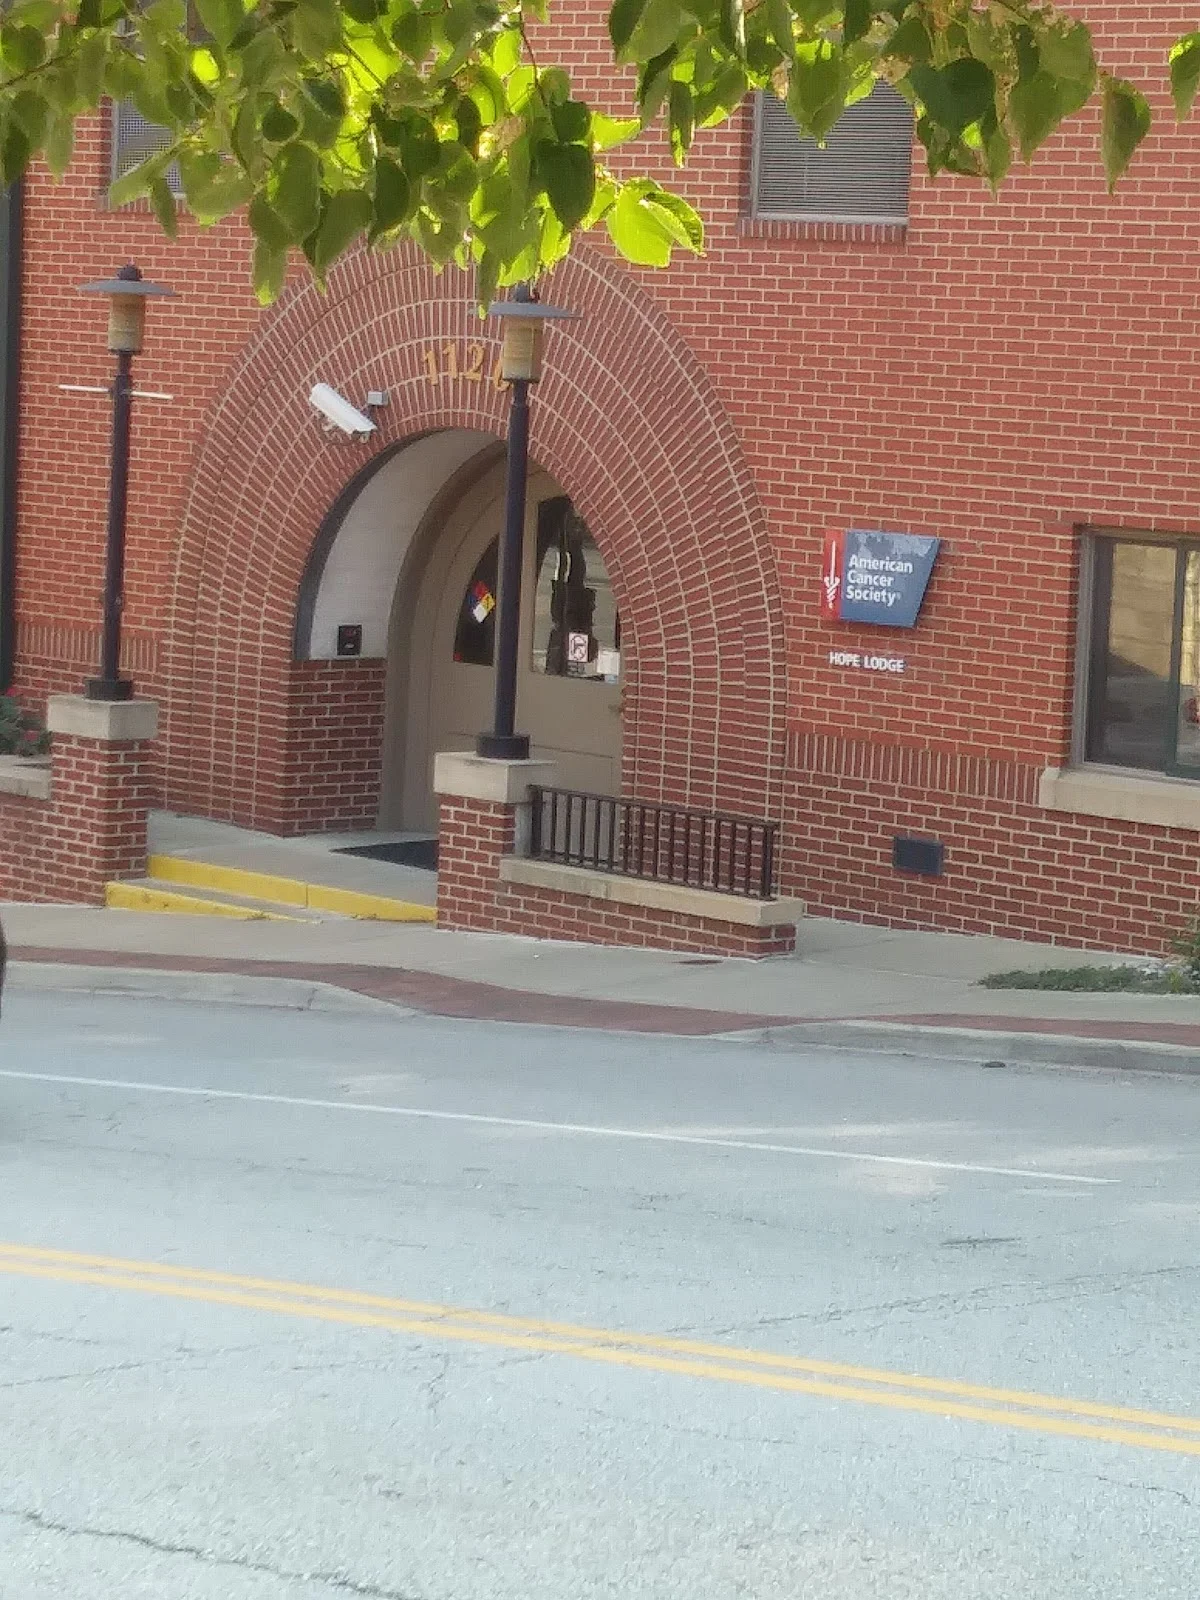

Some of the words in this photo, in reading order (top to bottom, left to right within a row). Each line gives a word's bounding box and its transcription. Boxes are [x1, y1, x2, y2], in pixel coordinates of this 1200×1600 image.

[849, 554, 912, 573] American
[847, 570, 894, 587] Cancer
[846, 586, 896, 606] Society
[829, 652, 860, 667] HOPE
[864, 656, 904, 672] LODGE
